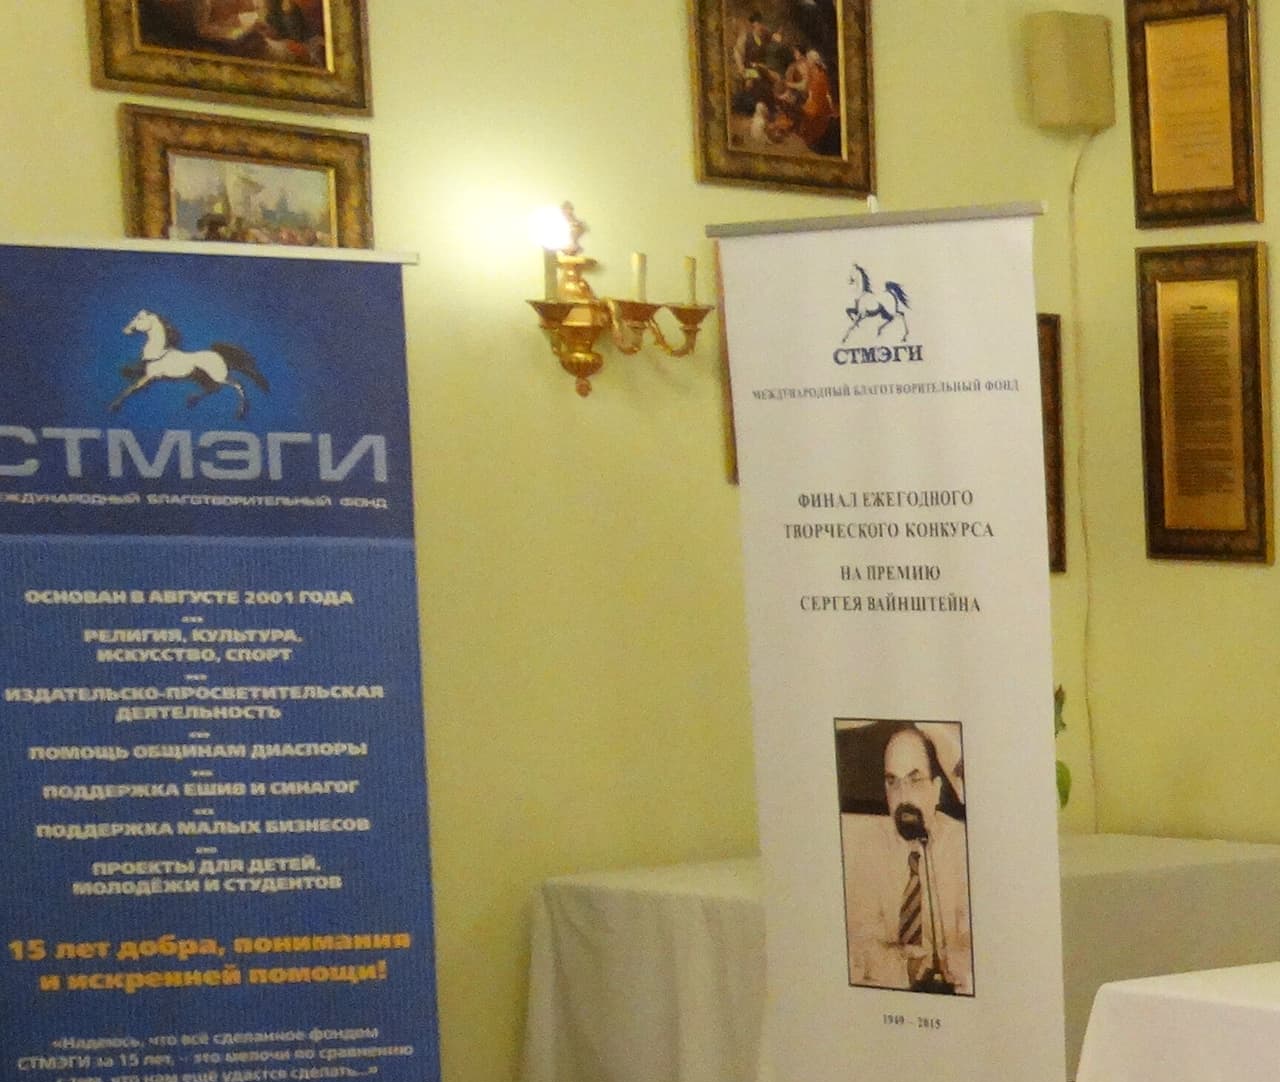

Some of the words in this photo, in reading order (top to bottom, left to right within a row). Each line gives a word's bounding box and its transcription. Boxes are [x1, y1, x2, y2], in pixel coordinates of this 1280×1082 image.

[833, 345, 924, 365] СТМЭГИ
[752, 384, 851, 401] МЕЖДУНАРОДНЫЙ
[853, 379, 981, 397] БЛАГОТВОРИТЕЛЬНЫЙ
[984, 378, 1019, 392] ФОНД
[0, 425, 387, 482] СТМЭГИ
[147, 494, 331, 507] БЛАГОТВОРИТЕЛЬНЫЙ
[340, 497, 388, 509] ФОНД
[798, 492, 857, 508] ФИНАЛ
[863, 489, 974, 507] ЕЖЕГОДНОГО
[784, 522, 899, 539] ТВОРЧЕСКОГО
[905, 521, 994, 537] КОНКУРСА
[840, 565, 862, 580] НА
[867, 565, 941, 580] ПРЕМИЮ
[24, 590, 127, 604] ОСНОВАН
[130, 590, 144, 603] В
[148, 590, 239, 604] АВГУСТЕ
[245, 590, 294, 604] 2001
[300, 590, 354, 606] ГОДА
[800, 596, 862, 611] СЕРГЕЯ
[867, 593, 980, 612] ВАЙНШТЕЙНА
[83, 628, 187, 643] РЕЛИГИЯ,
[96, 648, 221, 663] ИСКУССТВО,
[226, 648, 292, 661] СПОРТ
[5, 685, 384, 704] ИЗДАТЕЛЬСКО-ПРОСВЕТИТЕЛЬСКАЯ
[115, 706, 281, 723] ДЕЯТЕЛЬНОСТЬ
[29, 745, 129, 761] ПОМОЩЬ
[133, 743, 246, 760] ОБЩИНАМ
[251, 742, 368, 759] ДИАСПОРЫ
[42, 783, 179, 800] ПОДДЕРЖКА
[184, 782, 246, 796] ЕШИВ
[251, 782, 265, 795] И
[269, 780, 359, 795] СИНАГОГ
[36, 823, 173, 840] ПОДДЕРЖКА
[177, 821, 261, 834] МАЛЫХ
[265, 818, 371, 834] БИЗНЕСОВ
[92, 860, 195, 875] ПРОЕКТЫ
[199, 859, 244, 875] ДЛЯ
[72, 877, 199, 895] МОЛОДЁЖИ
[204, 879, 220, 892] И
[223, 876, 342, 893] СТУДЕНТОВ
[8, 939, 46, 961] 15
[55, 942, 110, 960] лет
[116, 933, 225, 961] добра,
[233, 933, 410, 954] понимания
[39, 974, 61, 991] и
[67, 967, 241, 994] искренней
[249, 959, 388, 984] помощи!
[149, 1035, 177, 1046] что
[213, 1031, 305, 1045] сделанное
[309, 1028, 378, 1042] фондом
[18, 1055, 91, 1070] СТМЭГИ
[119, 1053, 138, 1067] 15
[194, 1053, 220, 1064] это
[319, 1046, 413, 1061] сравнению
